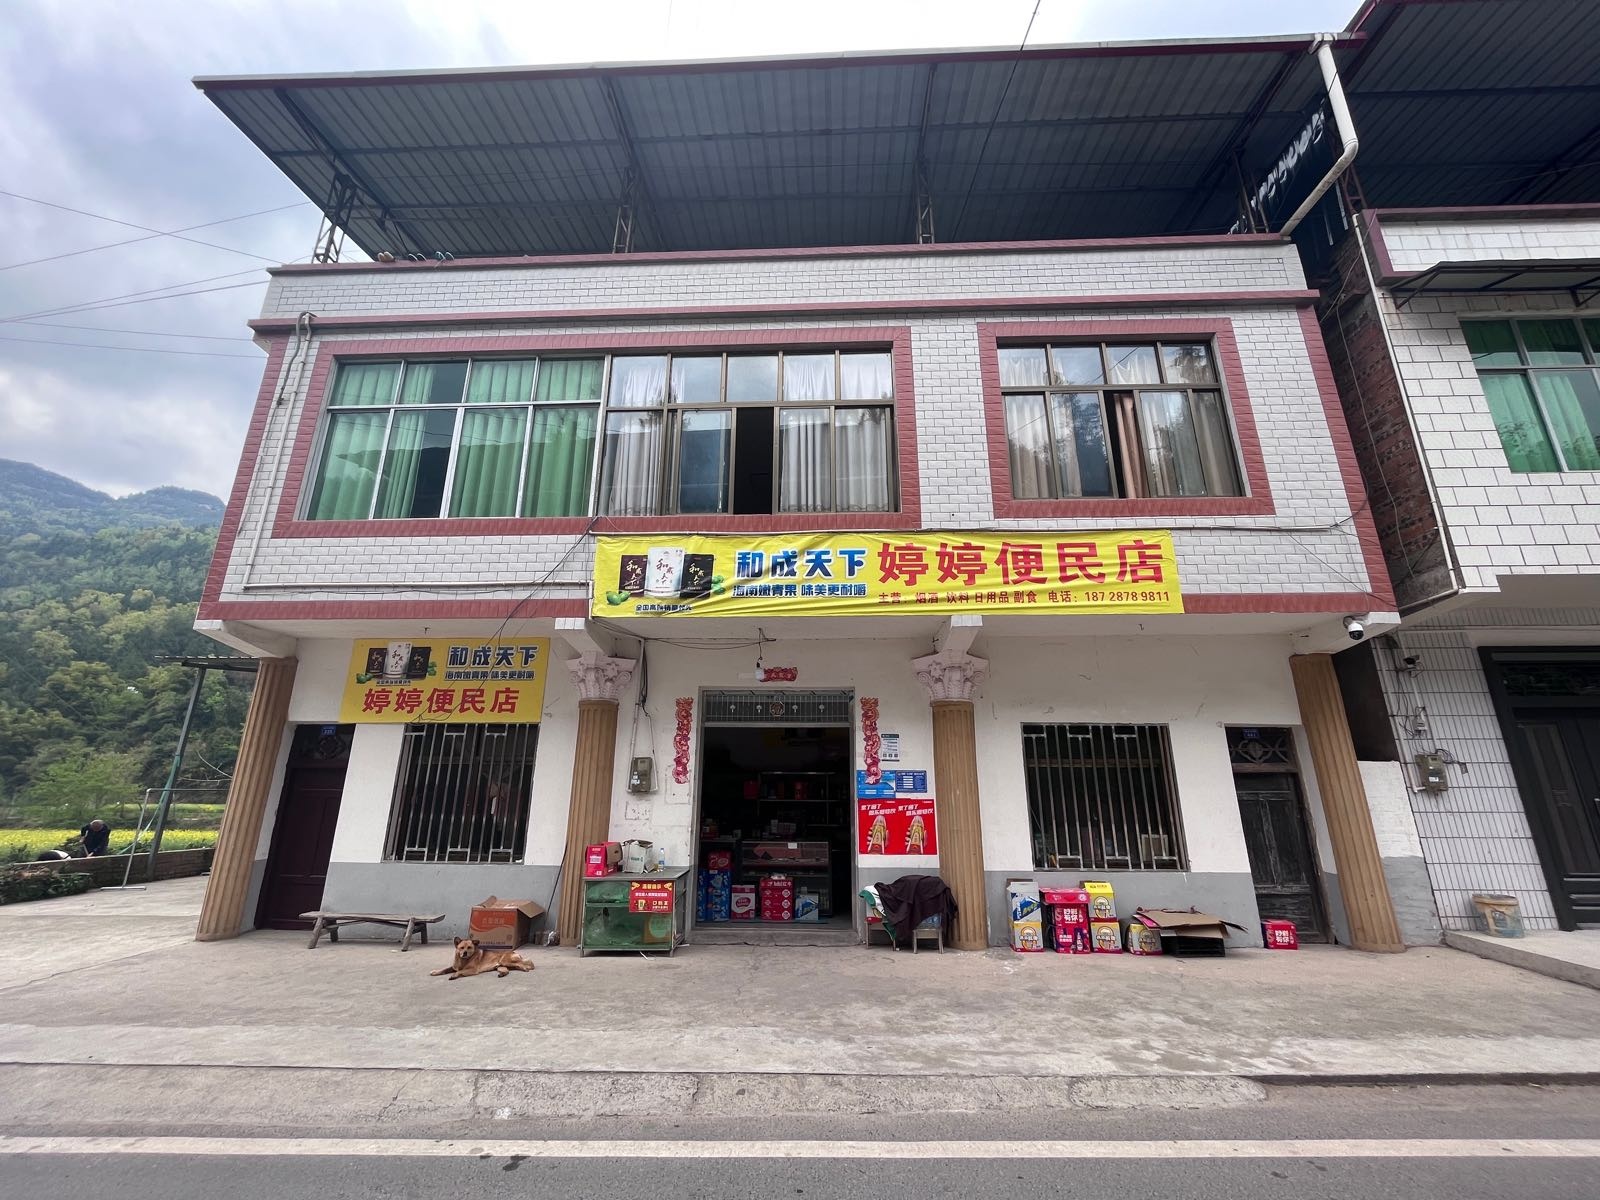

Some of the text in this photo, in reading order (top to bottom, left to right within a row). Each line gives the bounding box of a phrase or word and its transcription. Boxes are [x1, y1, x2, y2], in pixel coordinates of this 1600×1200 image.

[736, 548, 866, 579] 和成天下
[877, 539, 1164, 586] 婷婷便民店
[732, 583, 867, 597] 海南嫩青果 味美更耐嚼
[946, 591, 969, 603] 饮料
[975, 591, 1009, 603] 日用品
[1013, 590, 1037, 603] 副食
[448, 646, 537, 668] 和成天下
[362, 687, 520, 714] 婷婷便民店
